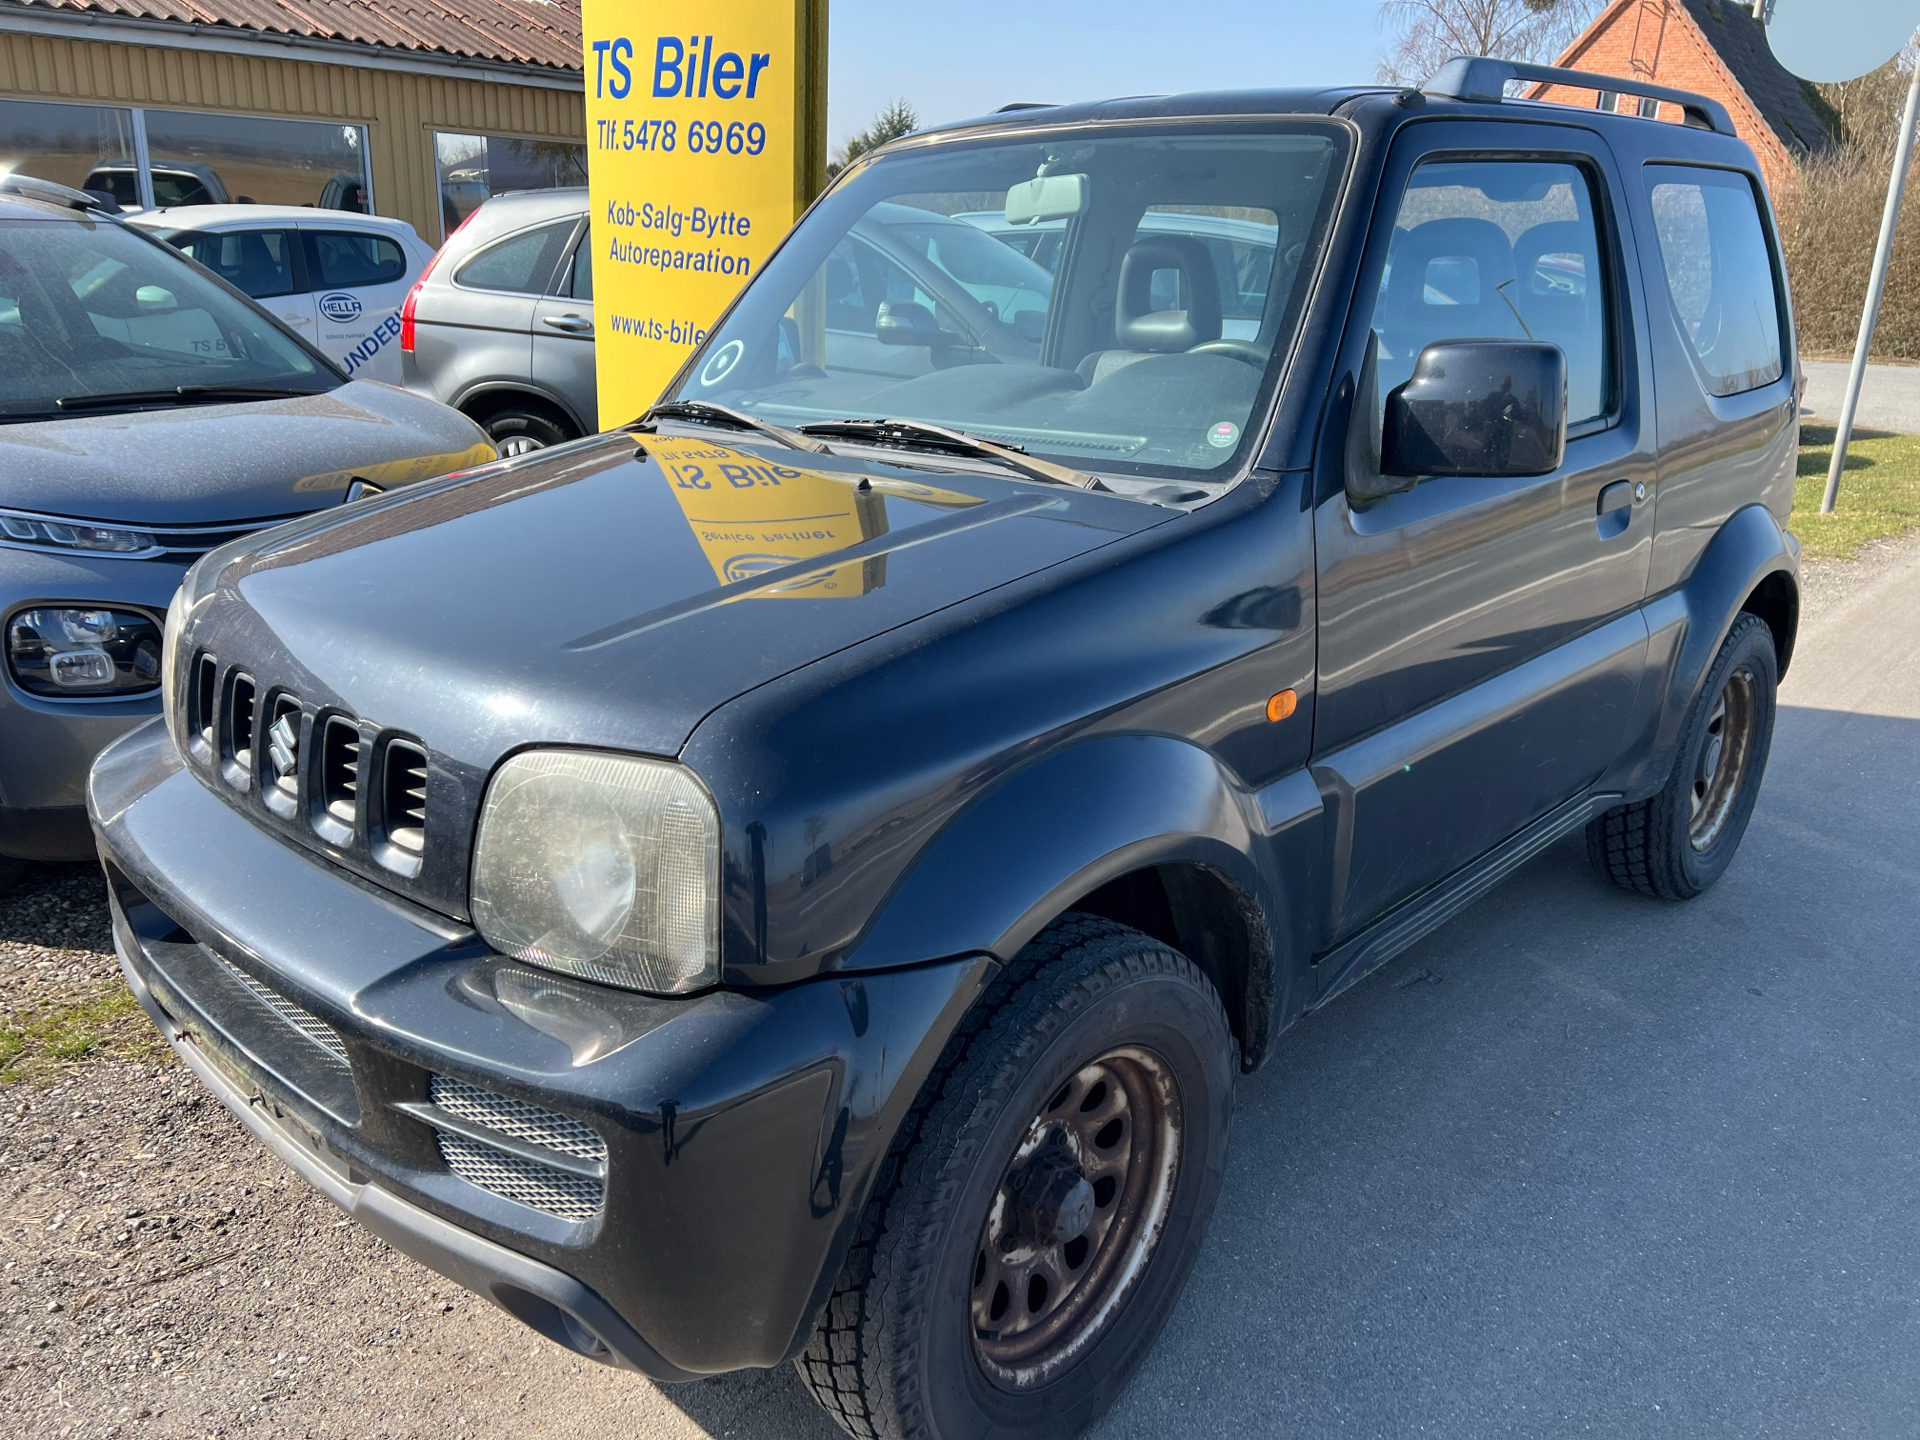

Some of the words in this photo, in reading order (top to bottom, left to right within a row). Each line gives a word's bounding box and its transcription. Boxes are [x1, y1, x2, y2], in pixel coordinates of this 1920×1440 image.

[592, 36, 634, 100] TS
[652, 35, 771, 100] Biler
[687, 120, 767, 156] 6969
[607, 200, 751, 237] Køb-Salg-Bytte
[609, 237, 751, 276] Autoreparation
[323, 301, 363, 312] HELLA
[190, 340, 211, 353] TS
[345, 332, 366, 340] PARTNER
